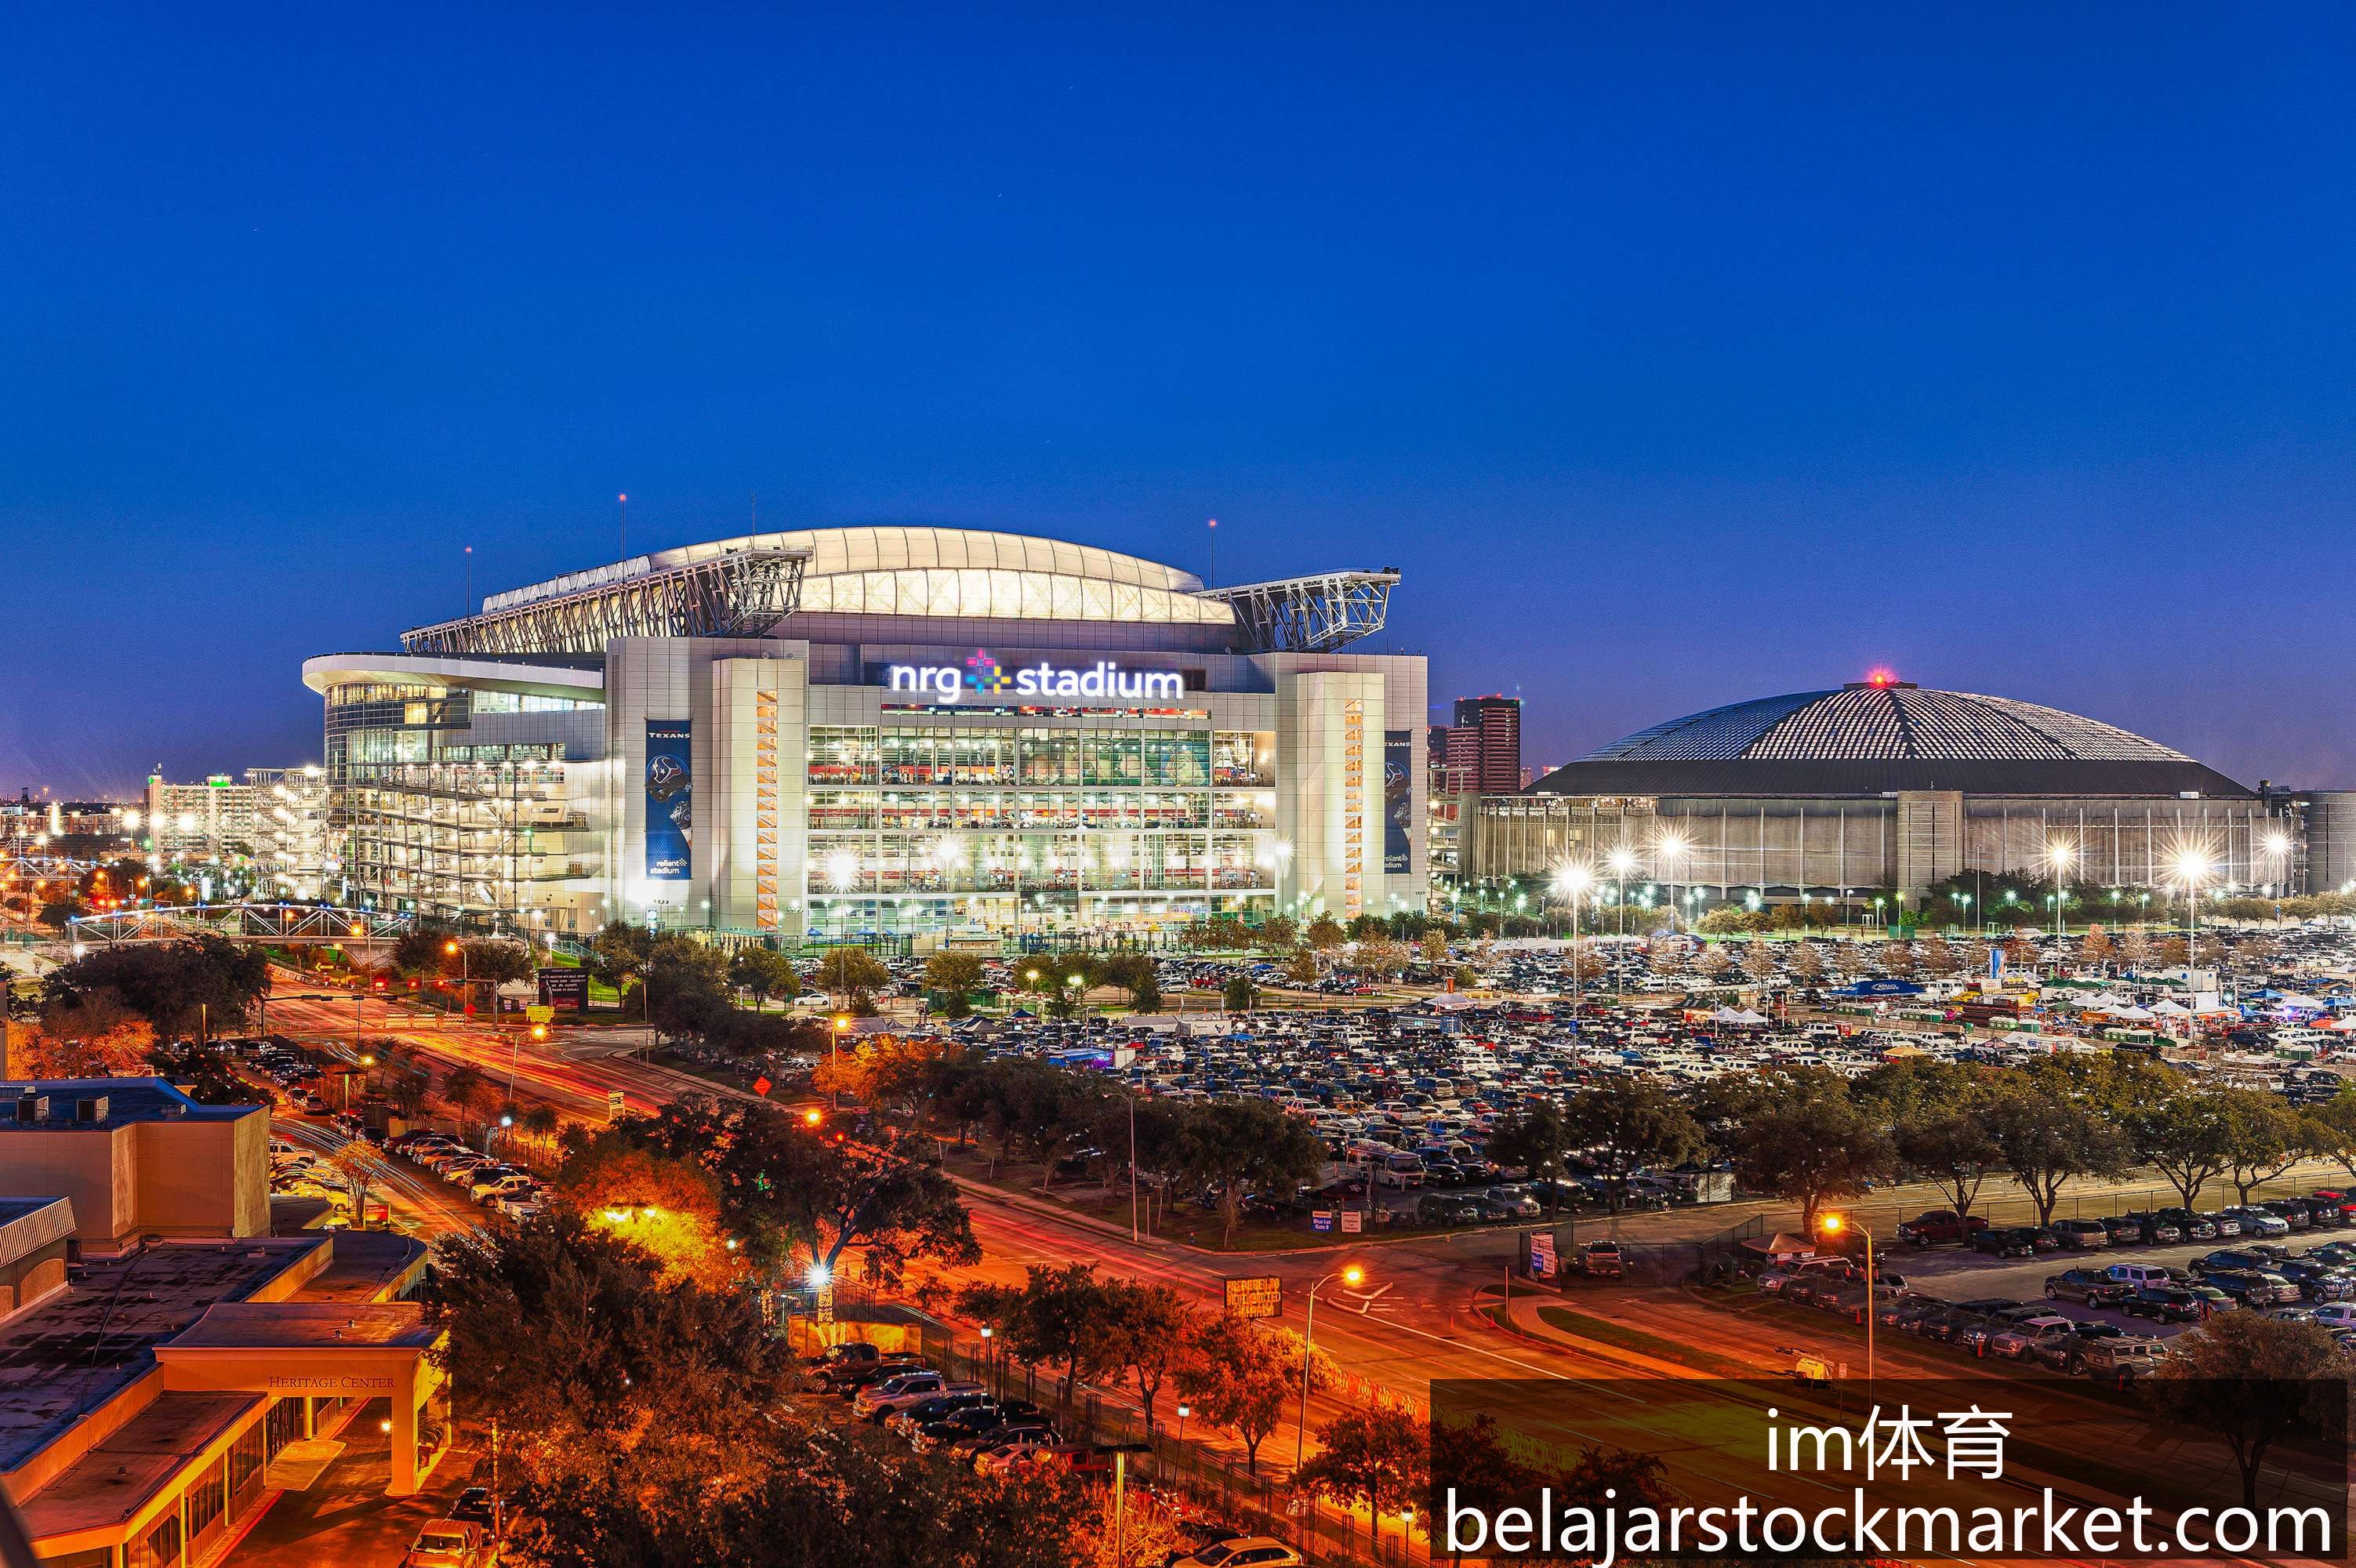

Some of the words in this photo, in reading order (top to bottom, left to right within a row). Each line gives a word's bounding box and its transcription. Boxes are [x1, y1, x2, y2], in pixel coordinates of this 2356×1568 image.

[891, 665, 962, 704] nrg
[1015, 661, 1185, 699] stadium
[269, 1376, 338, 1388] HERITAGE
[341, 1376, 395, 1388] CENTER
